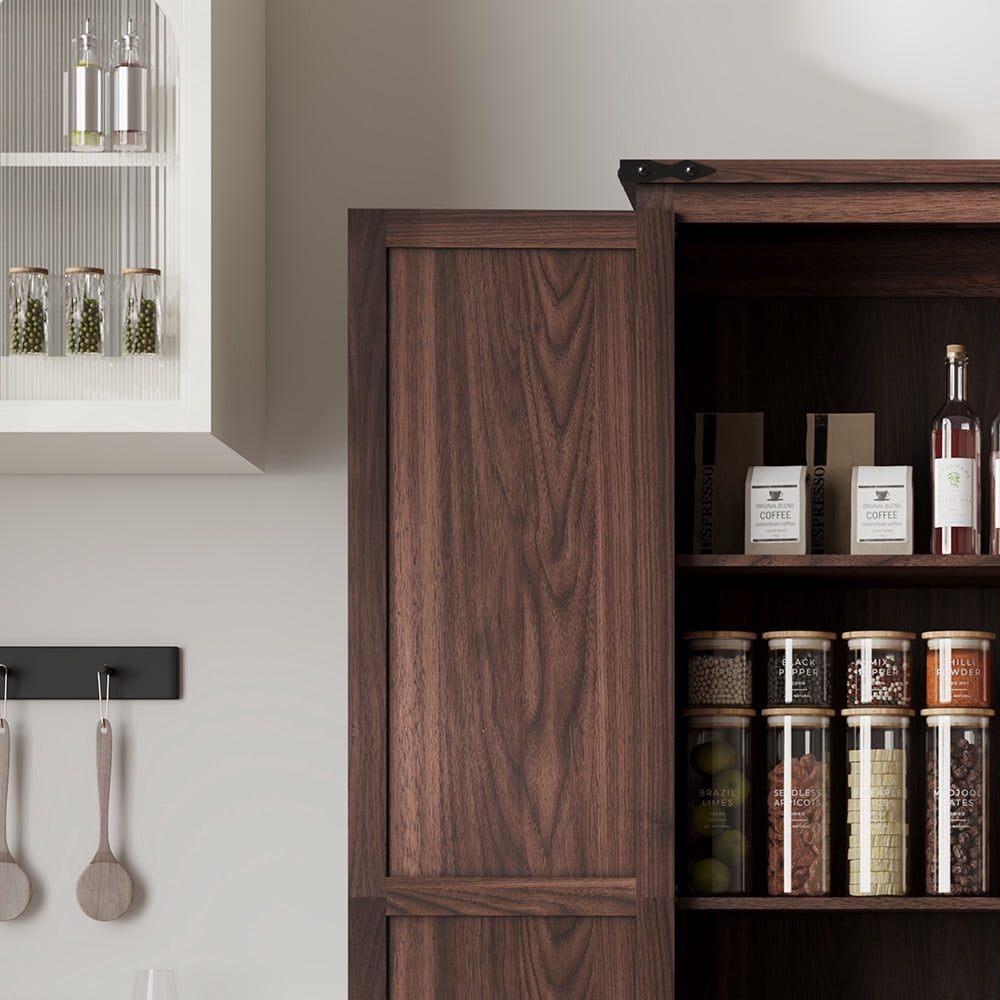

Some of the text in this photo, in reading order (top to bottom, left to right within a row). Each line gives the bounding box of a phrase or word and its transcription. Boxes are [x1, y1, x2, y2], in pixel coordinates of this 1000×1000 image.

[813, 467, 825, 548] ESPRESSO
[760, 511, 791, 520] COFFEE
[866, 511, 898, 520] COFFEE
[778, 668, 819, 677] PPPER
[699, 788, 736, 797] BRAZIL
[774, 788, 822, 797] SEDLESS
[702, 798, 734, 807] LIMES
[945, 798, 974, 807] ATES
